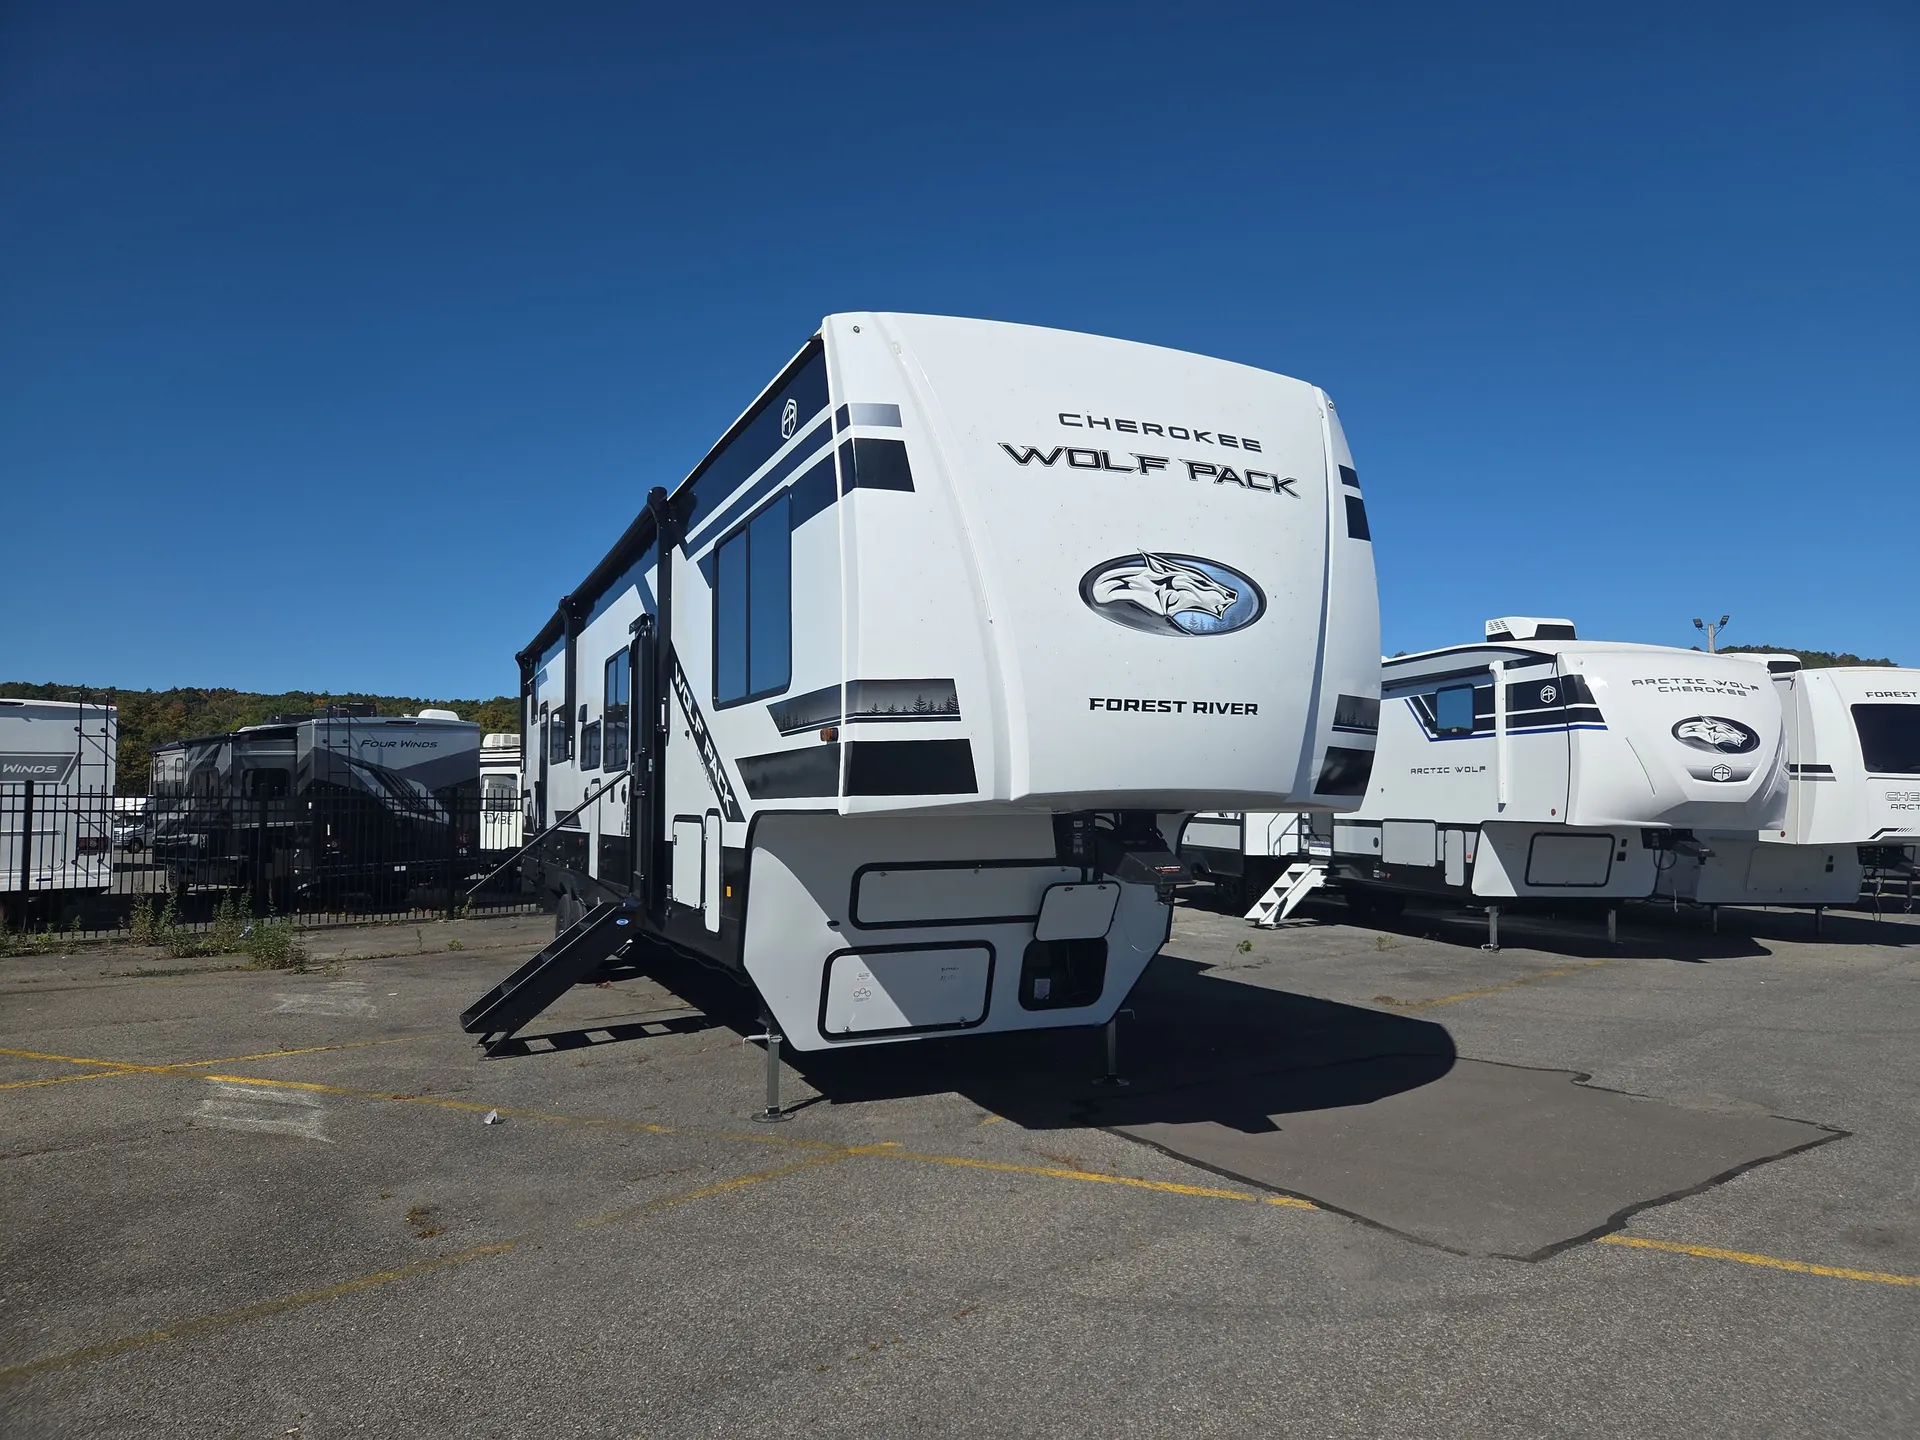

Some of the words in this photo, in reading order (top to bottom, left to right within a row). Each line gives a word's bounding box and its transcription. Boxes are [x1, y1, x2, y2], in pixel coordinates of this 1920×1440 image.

[1058, 412, 1262, 453] CHEROKEE
[997, 442, 1170, 476] WOLF
[1178, 458, 1302, 499] PACK
[1631, 678, 1707, 686] ARCTIC
[1713, 679, 1760, 692] WOLF
[1657, 686, 1748, 697] CHEROKEE
[1089, 697, 1187, 713] FOREST
[1192, 701, 1259, 715] RIVER
[400, 739, 438, 749] WINDS
[675, 662, 704, 735] WOLF
[704, 734, 734, 817] PACK
[2, 763, 58, 774] WINDS
[1455, 765, 1486, 773] WOLF
